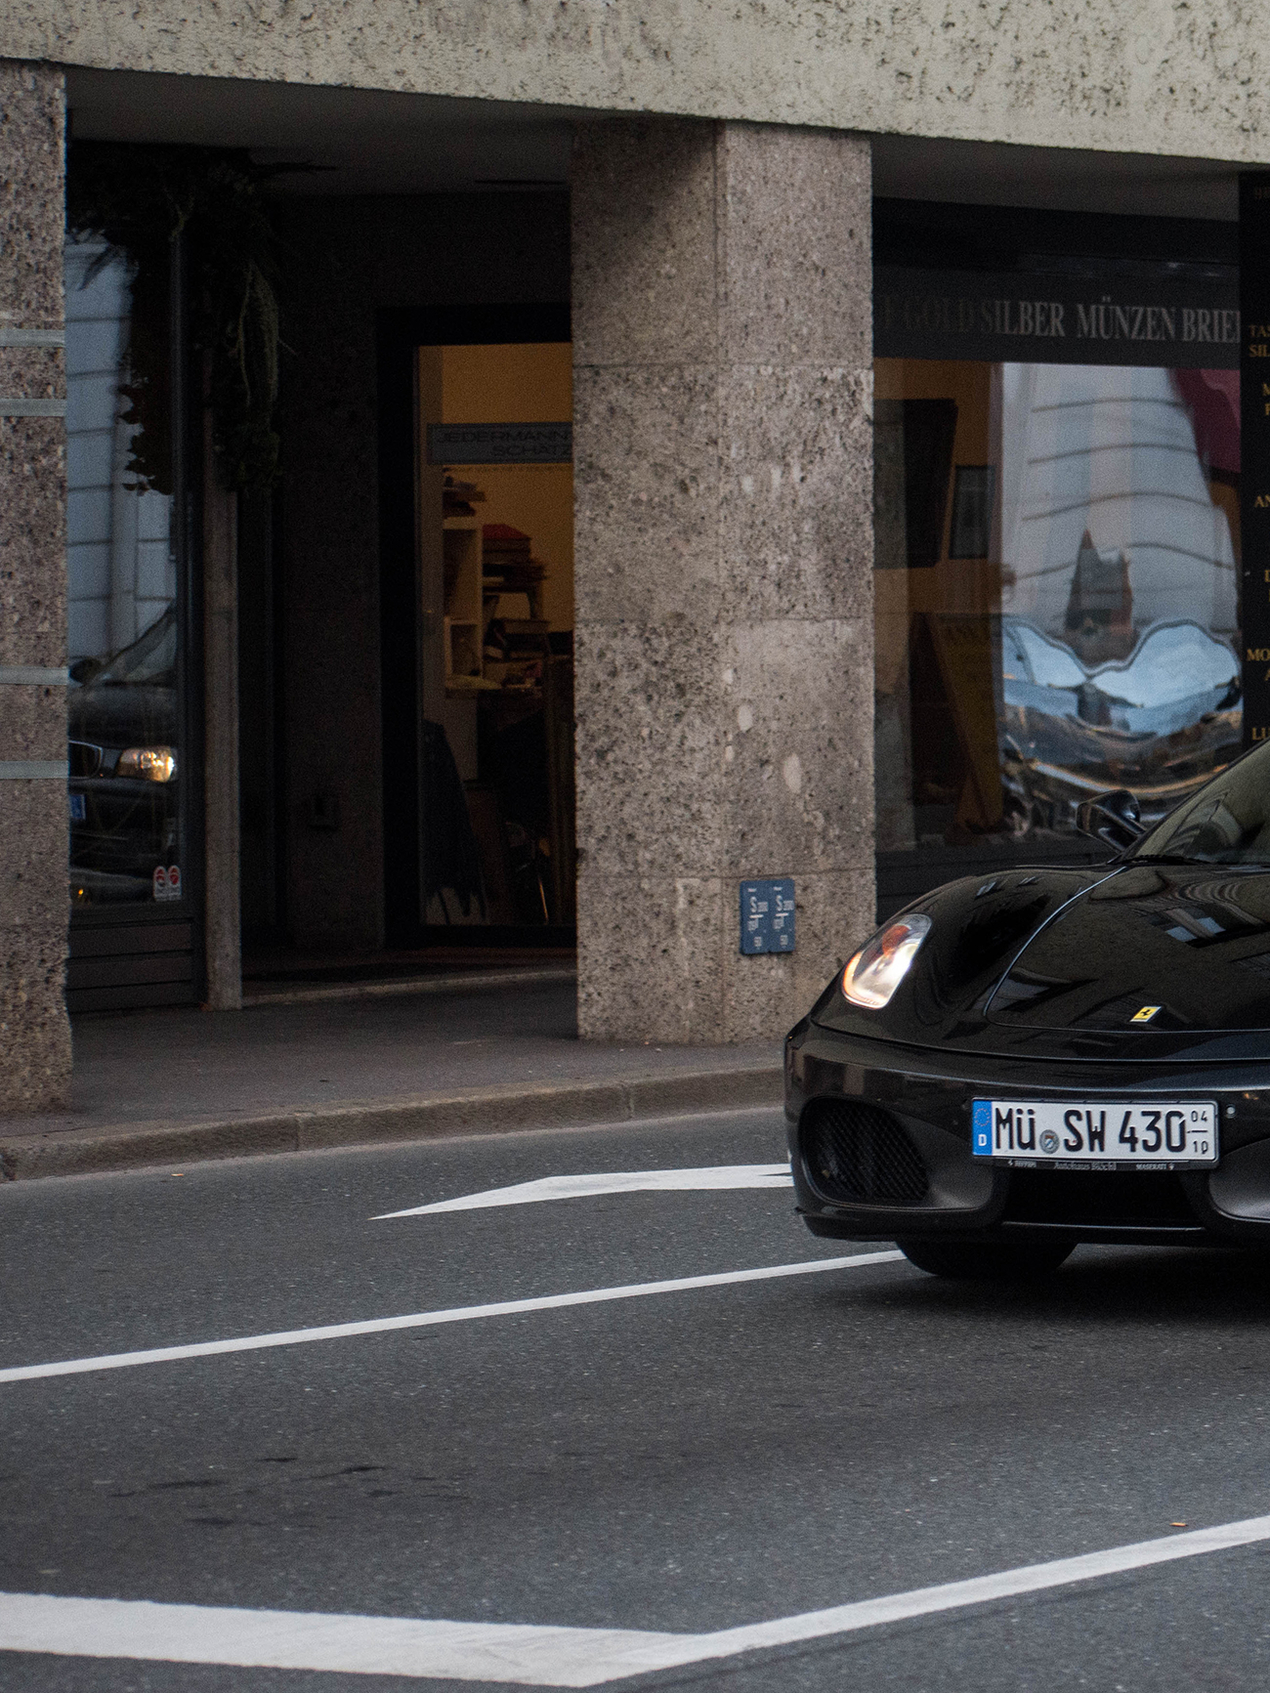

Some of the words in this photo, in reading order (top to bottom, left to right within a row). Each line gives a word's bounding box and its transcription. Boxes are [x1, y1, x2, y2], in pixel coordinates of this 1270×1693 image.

[980, 298, 1066, 337] SILBER
[1076, 295, 1177, 341] MÜNZEN
[1191, 1110, 1208, 1122] 04
[978, 1134, 987, 1146] D
[1064, 1109, 1106, 1153] SW
[1119, 1110, 1187, 1153] 430
